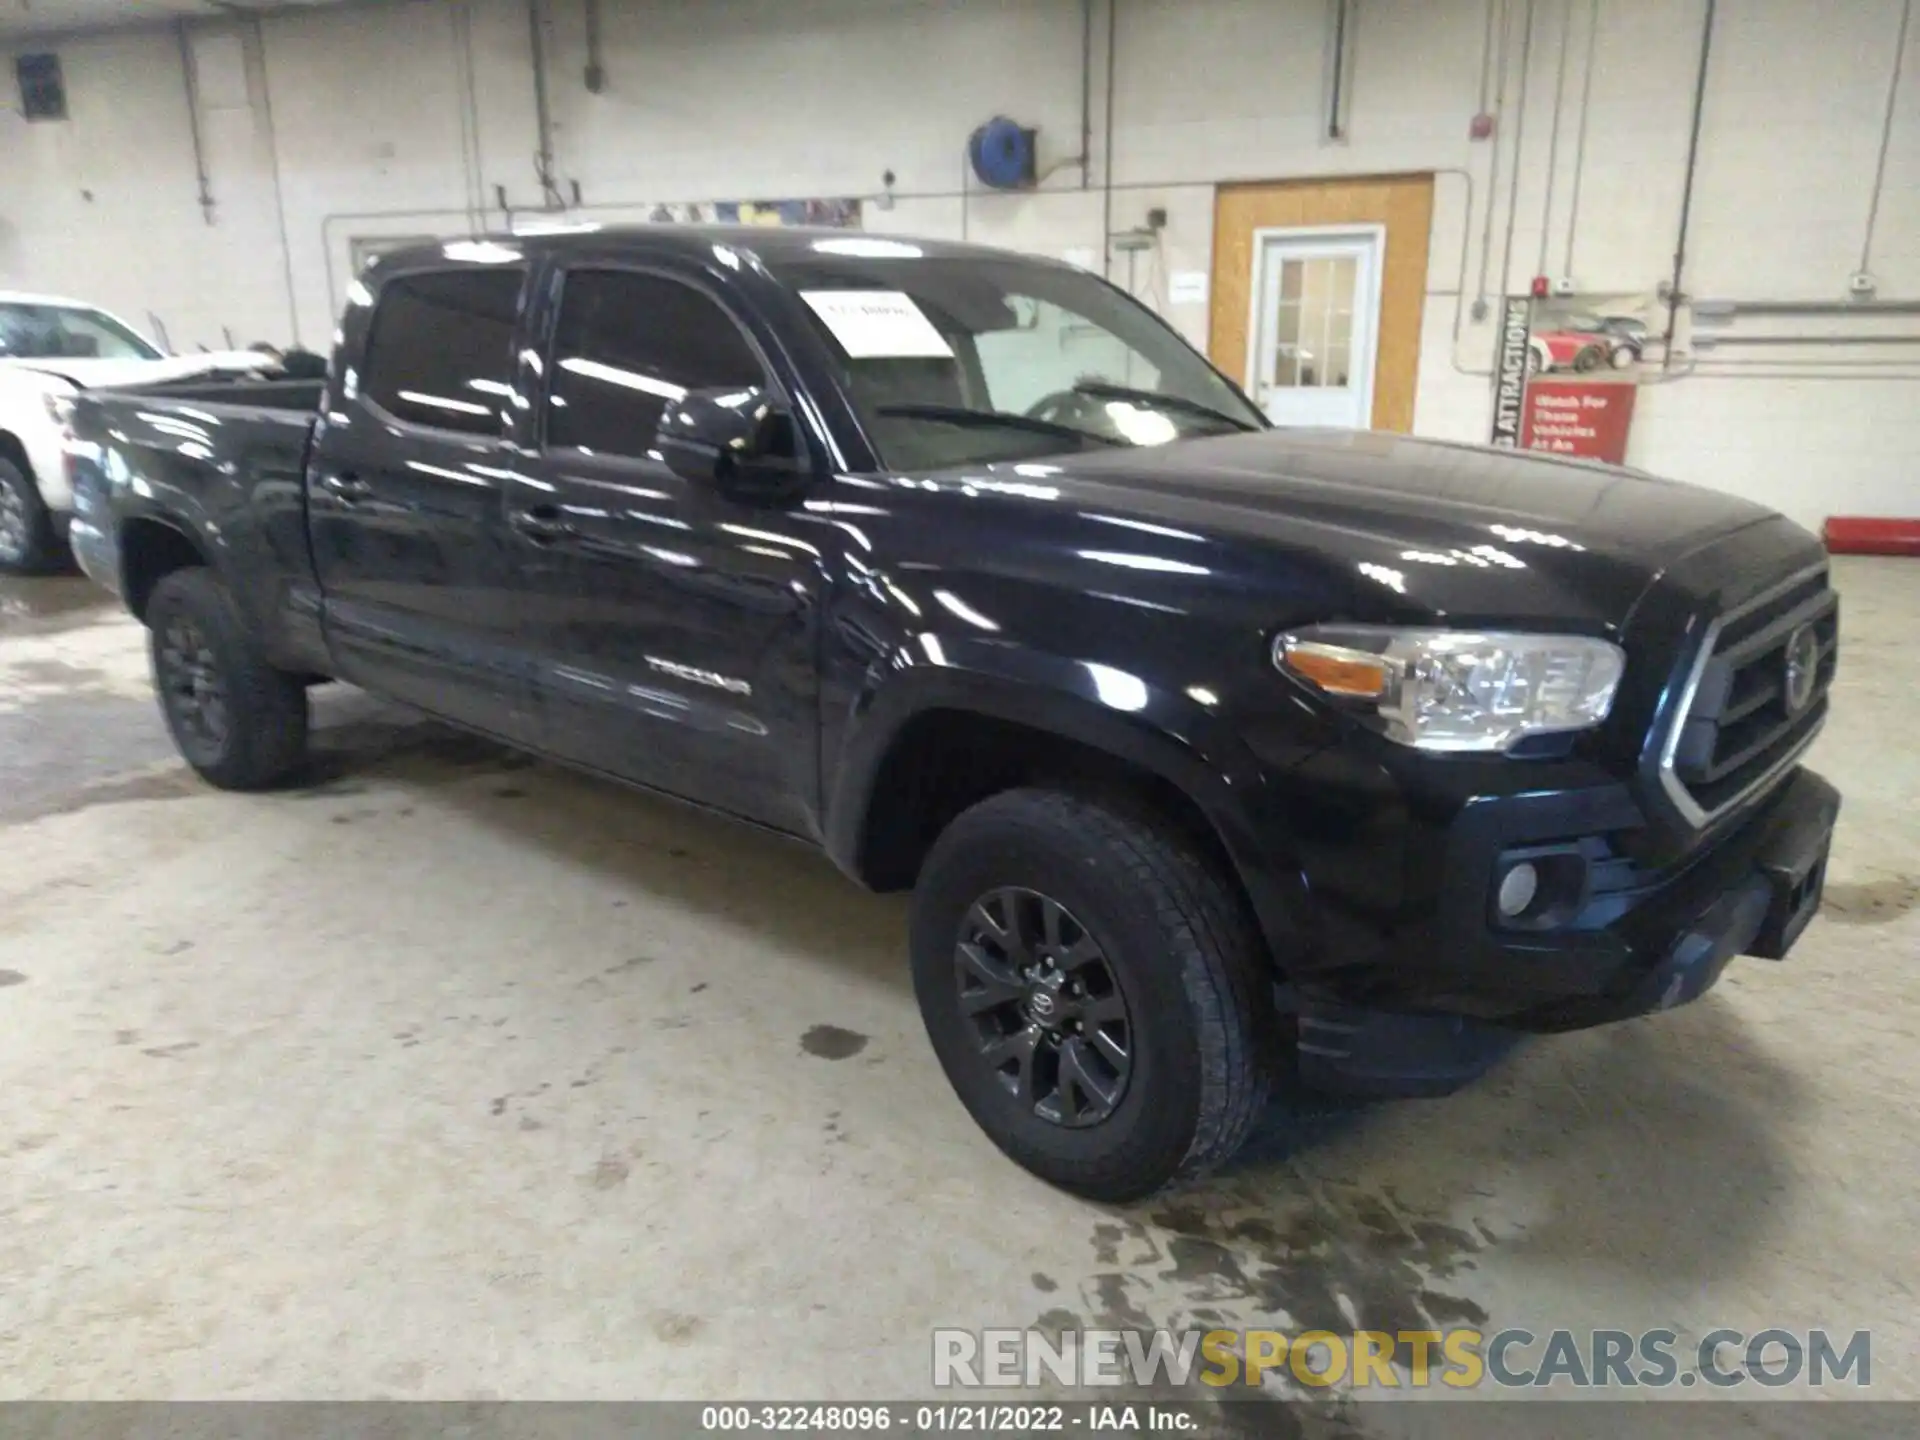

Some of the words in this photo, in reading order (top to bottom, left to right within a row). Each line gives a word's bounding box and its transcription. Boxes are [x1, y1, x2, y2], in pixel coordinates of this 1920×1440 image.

[1498, 300, 1528, 434] ATTRACTIONS
[1535, 394, 1579, 408] Watch
[1582, 395, 1608, 409] For
[1534, 409, 1579, 423] These
[1532, 424, 1597, 438] Vehicles
